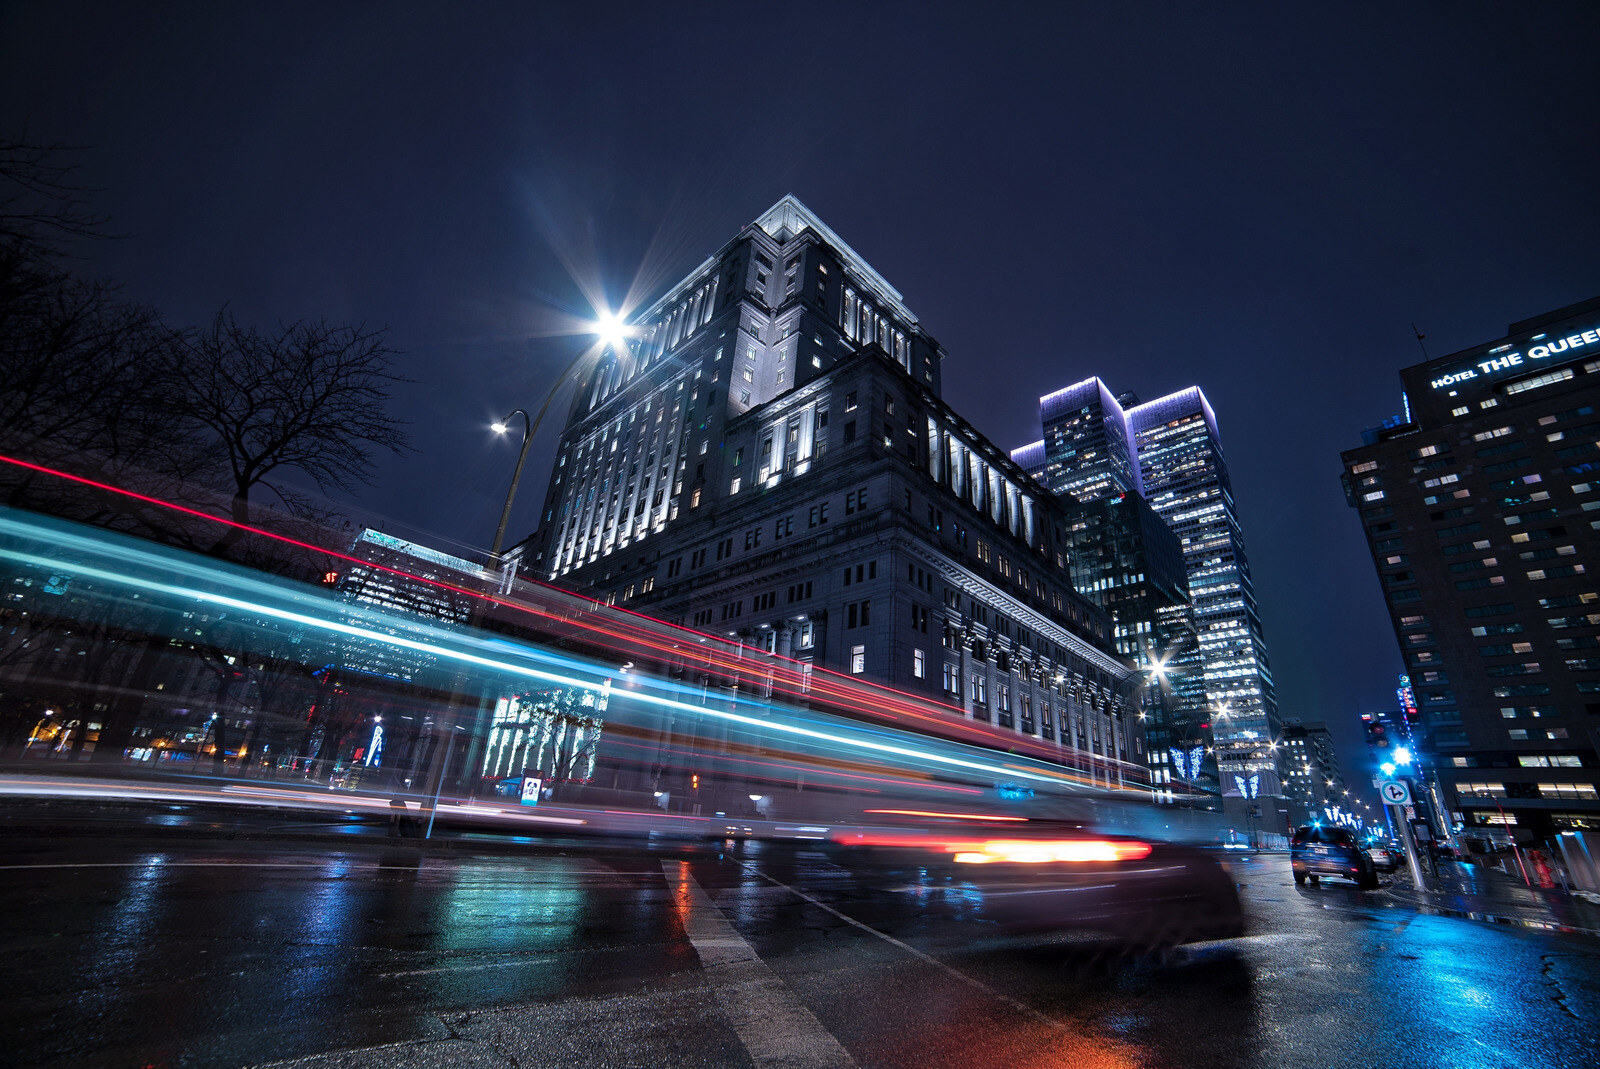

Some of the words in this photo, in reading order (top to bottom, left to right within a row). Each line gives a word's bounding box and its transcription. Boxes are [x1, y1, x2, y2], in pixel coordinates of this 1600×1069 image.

[1431, 371, 1478, 389] HÔTEL
[1477, 353, 1523, 374] THE
[1527, 328, 1600, 359] QUEE
